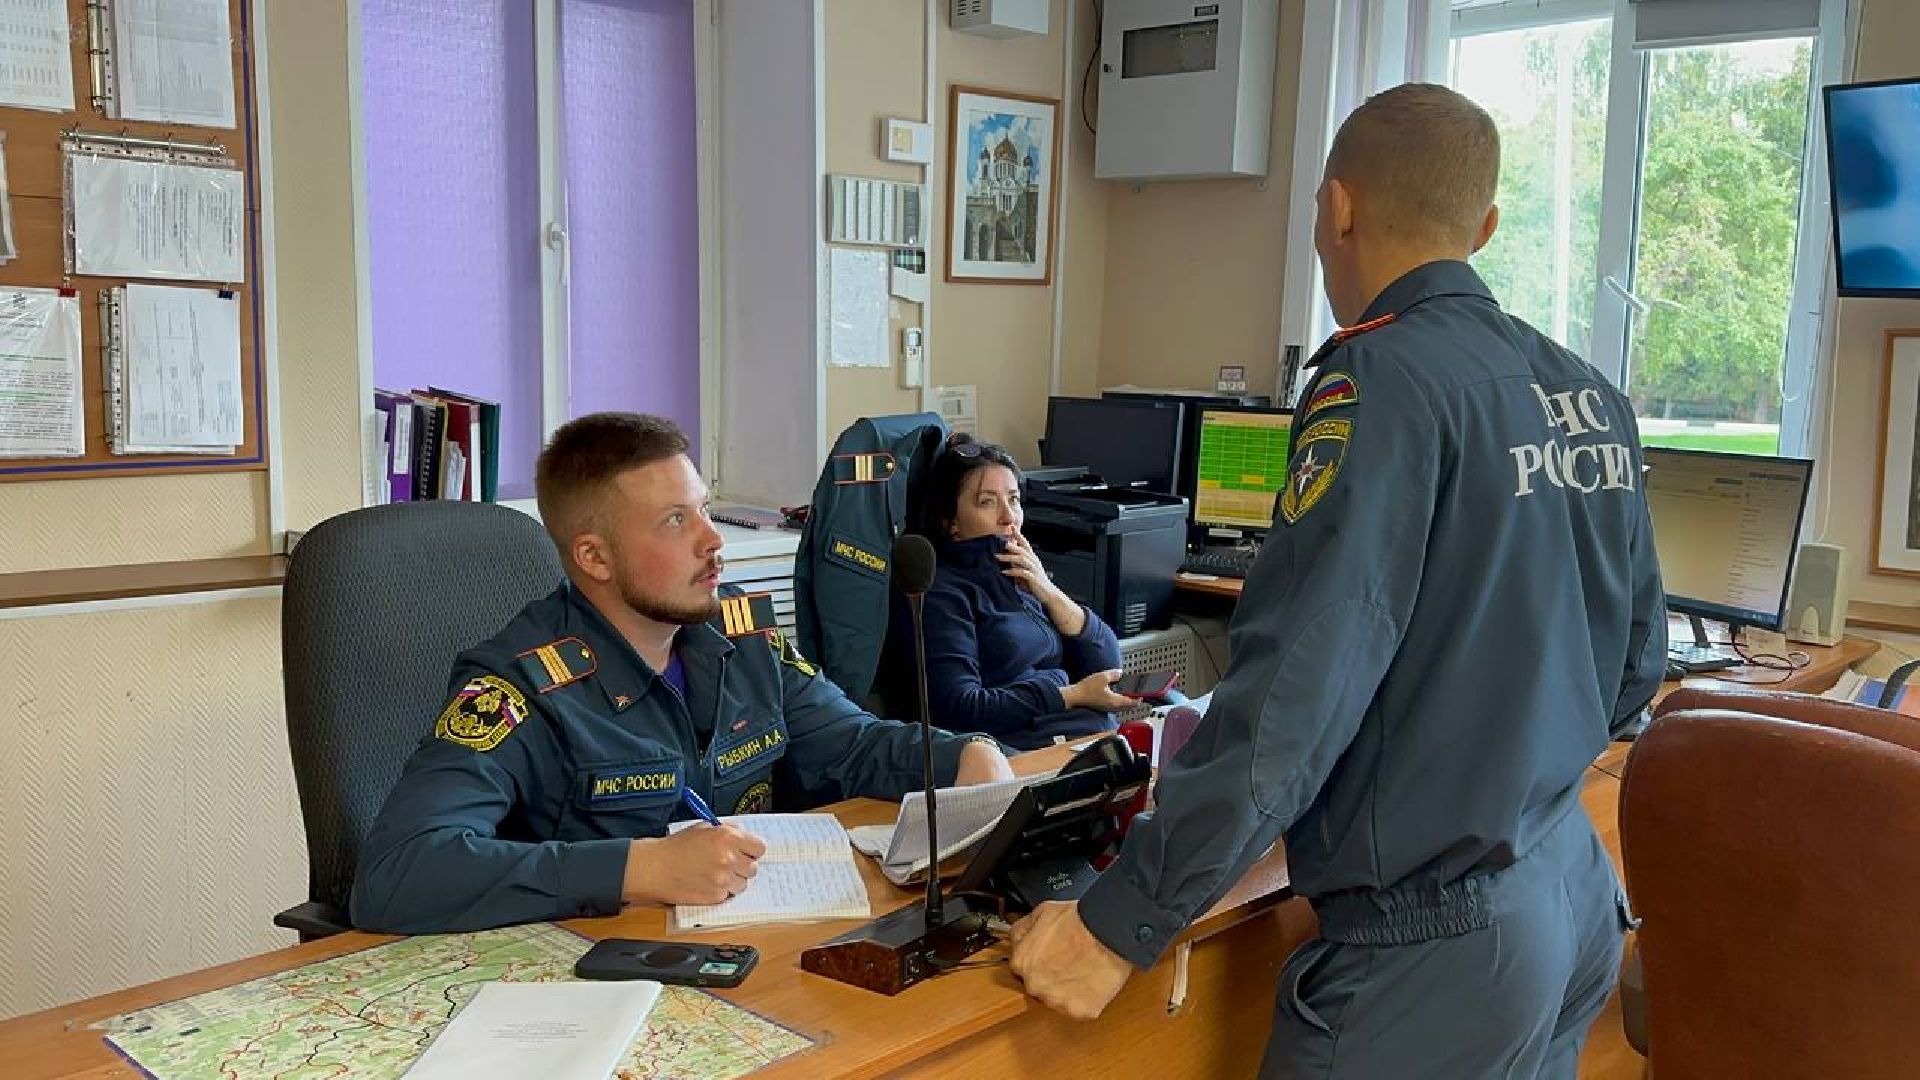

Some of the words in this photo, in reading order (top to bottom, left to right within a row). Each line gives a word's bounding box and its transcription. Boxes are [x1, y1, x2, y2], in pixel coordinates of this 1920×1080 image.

[834, 540, 854, 557] МЧС
[855, 549, 886, 573] РОССИИ
[717, 740, 763, 770] РЫБКИН
[594, 777, 622, 796] МЧС
[626, 773, 676, 793] РОССИИ
